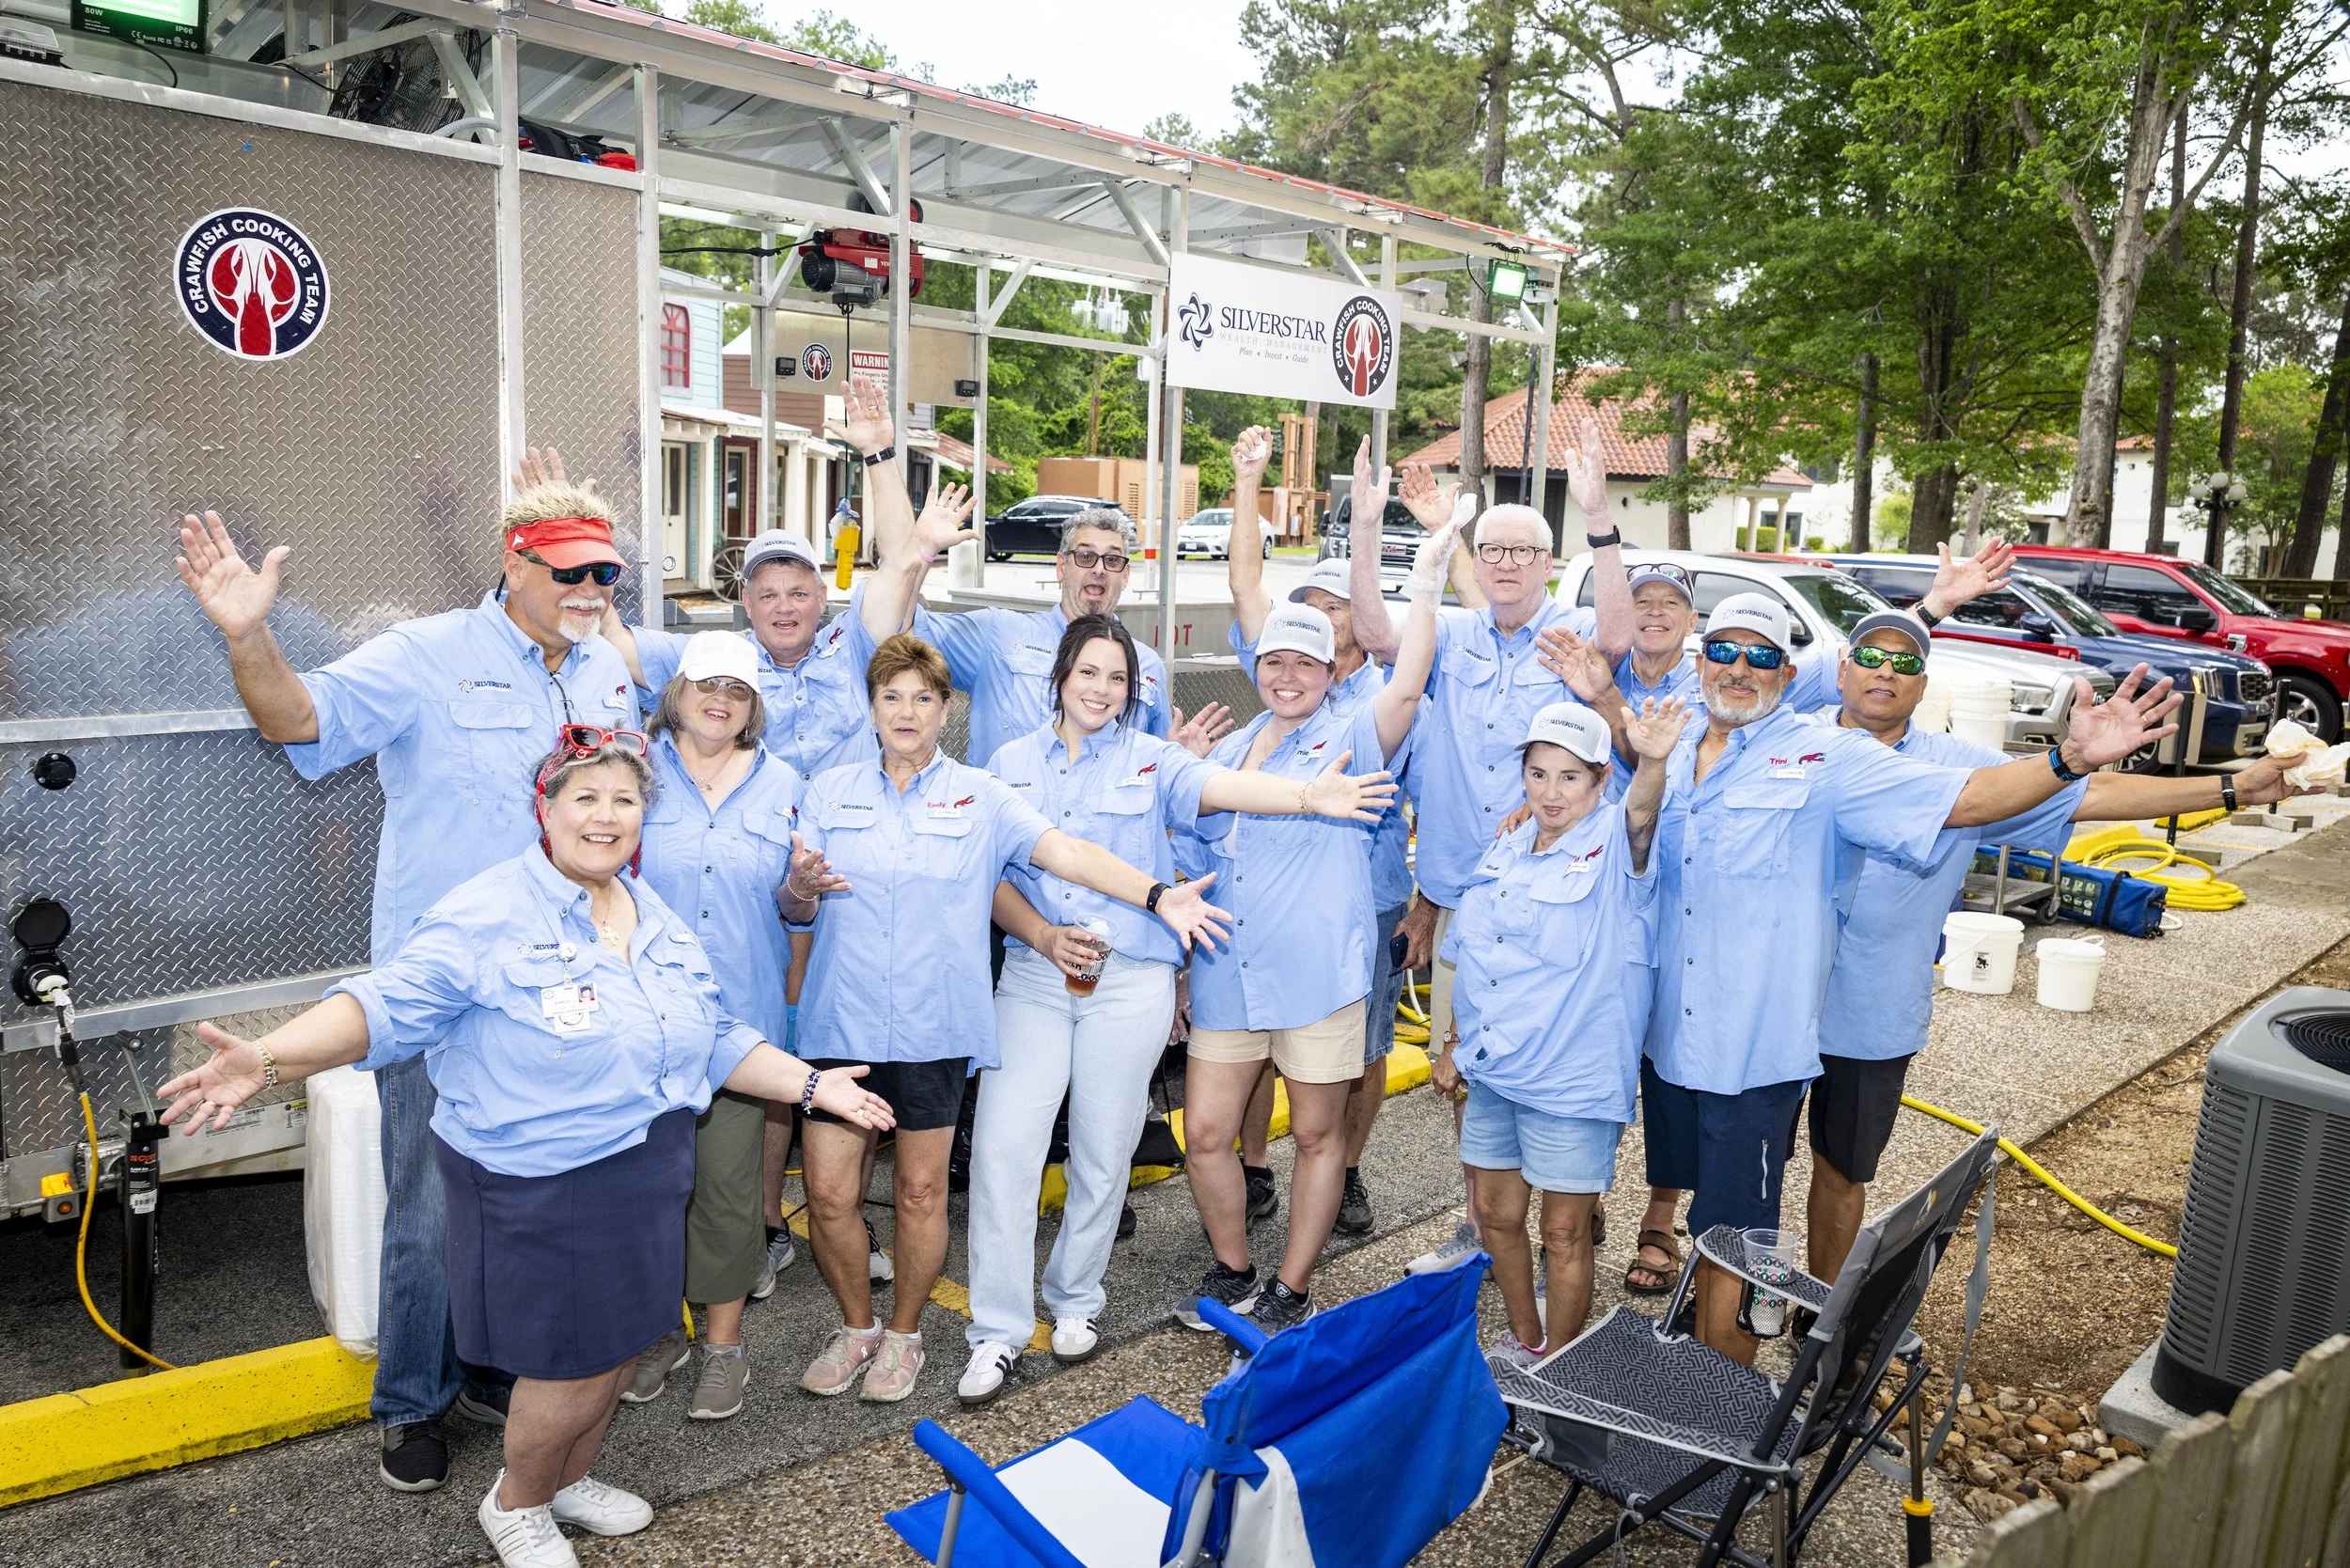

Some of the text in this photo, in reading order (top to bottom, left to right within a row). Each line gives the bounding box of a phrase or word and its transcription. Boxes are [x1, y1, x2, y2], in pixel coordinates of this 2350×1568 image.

[85, 7, 103, 16] 80W
[175, 25, 194, 35] IP66
[185, 219, 320, 325] CRAWFISH COOKING TEAM
[1220, 306, 1327, 344] SILVERSTAR
[1220, 333, 1327, 354] WEALTH MANAGEMENT
[1335, 301, 1390, 374] CRAWFISH COOKING TEAM
[853, 353, 888, 368] WARNIN
[1239, 346, 1309, 364] Plan Invest Guide
[1736, 609, 1773, 622] SILVERSTAR
[1286, 620, 1321, 634] SILVERSTAR
[474, 681, 511, 689] SILVERSTAR
[1549, 718, 1586, 733] SILVERSTAR
